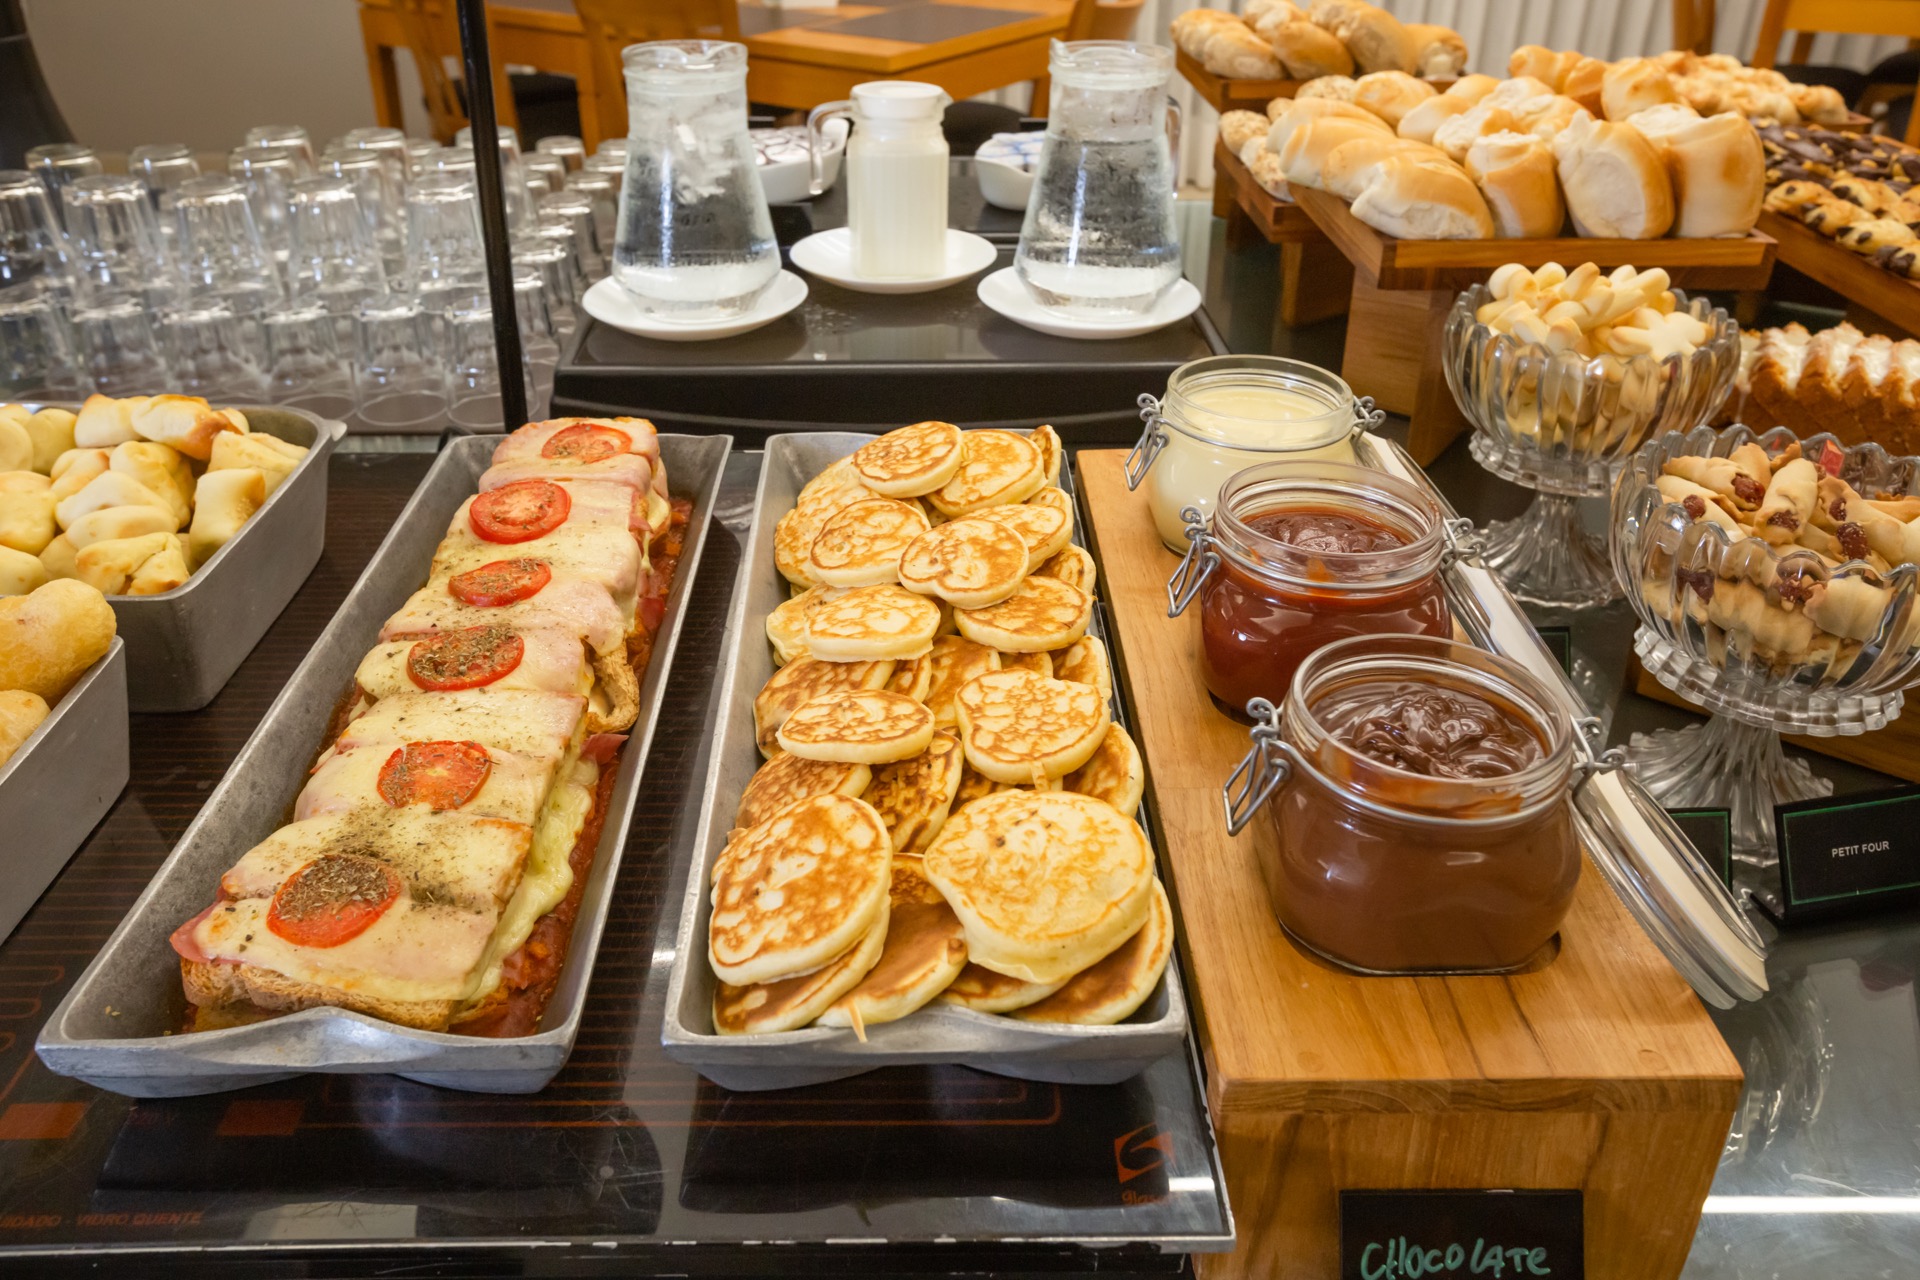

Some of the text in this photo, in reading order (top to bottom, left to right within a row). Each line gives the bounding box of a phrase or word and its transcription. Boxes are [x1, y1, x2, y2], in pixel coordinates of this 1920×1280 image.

[1831, 841, 1890, 858] PETIT FOUR
[76, 1213, 130, 1227] VIDRO
[132, 1211, 204, 1226] QUENTE
